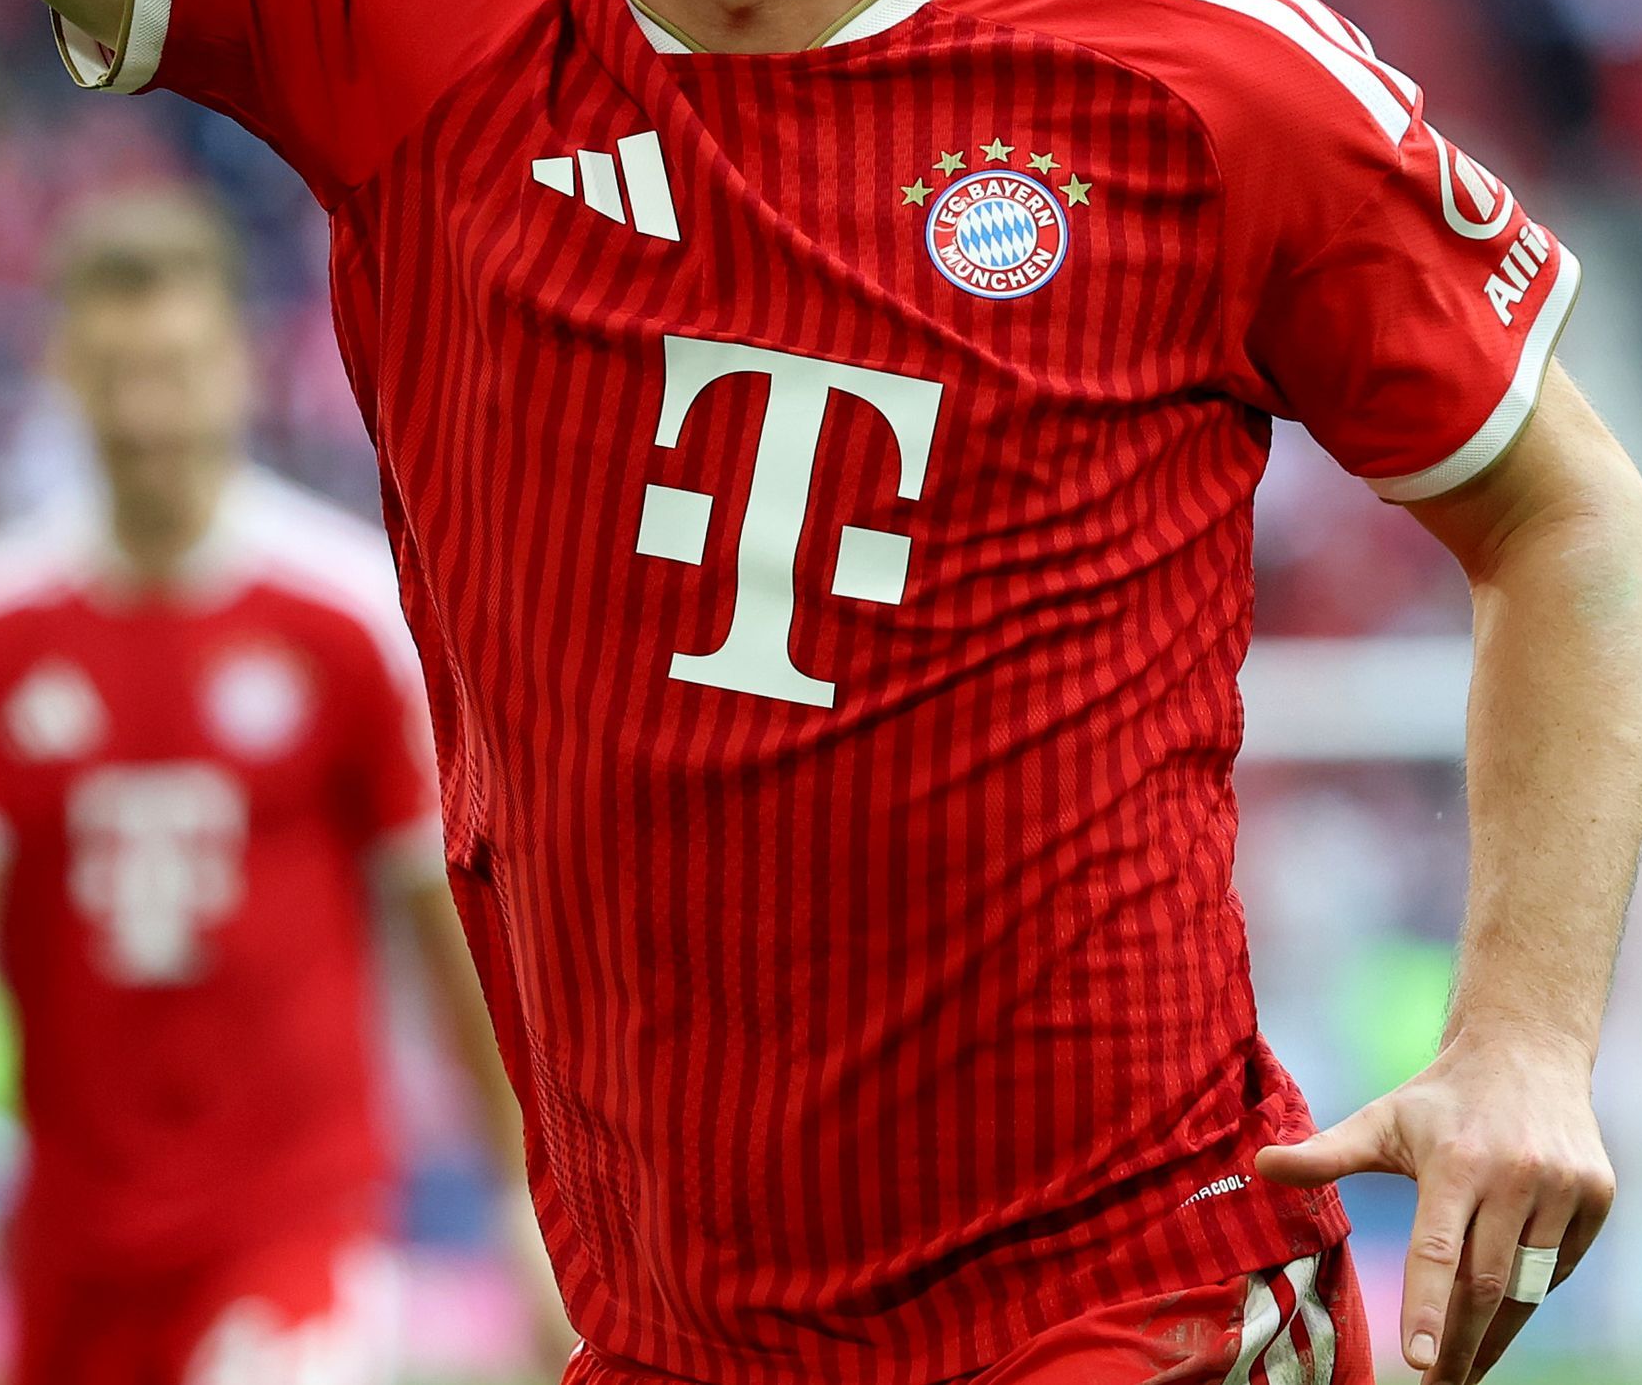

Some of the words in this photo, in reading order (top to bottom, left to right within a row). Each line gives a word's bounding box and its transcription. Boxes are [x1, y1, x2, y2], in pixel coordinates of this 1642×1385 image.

[939, 196, 967, 225] FC
[967, 179, 1055, 228] BAYERN
[939, 244, 1053, 290] MÜNCHEN
[637, 334, 944, 709] T
